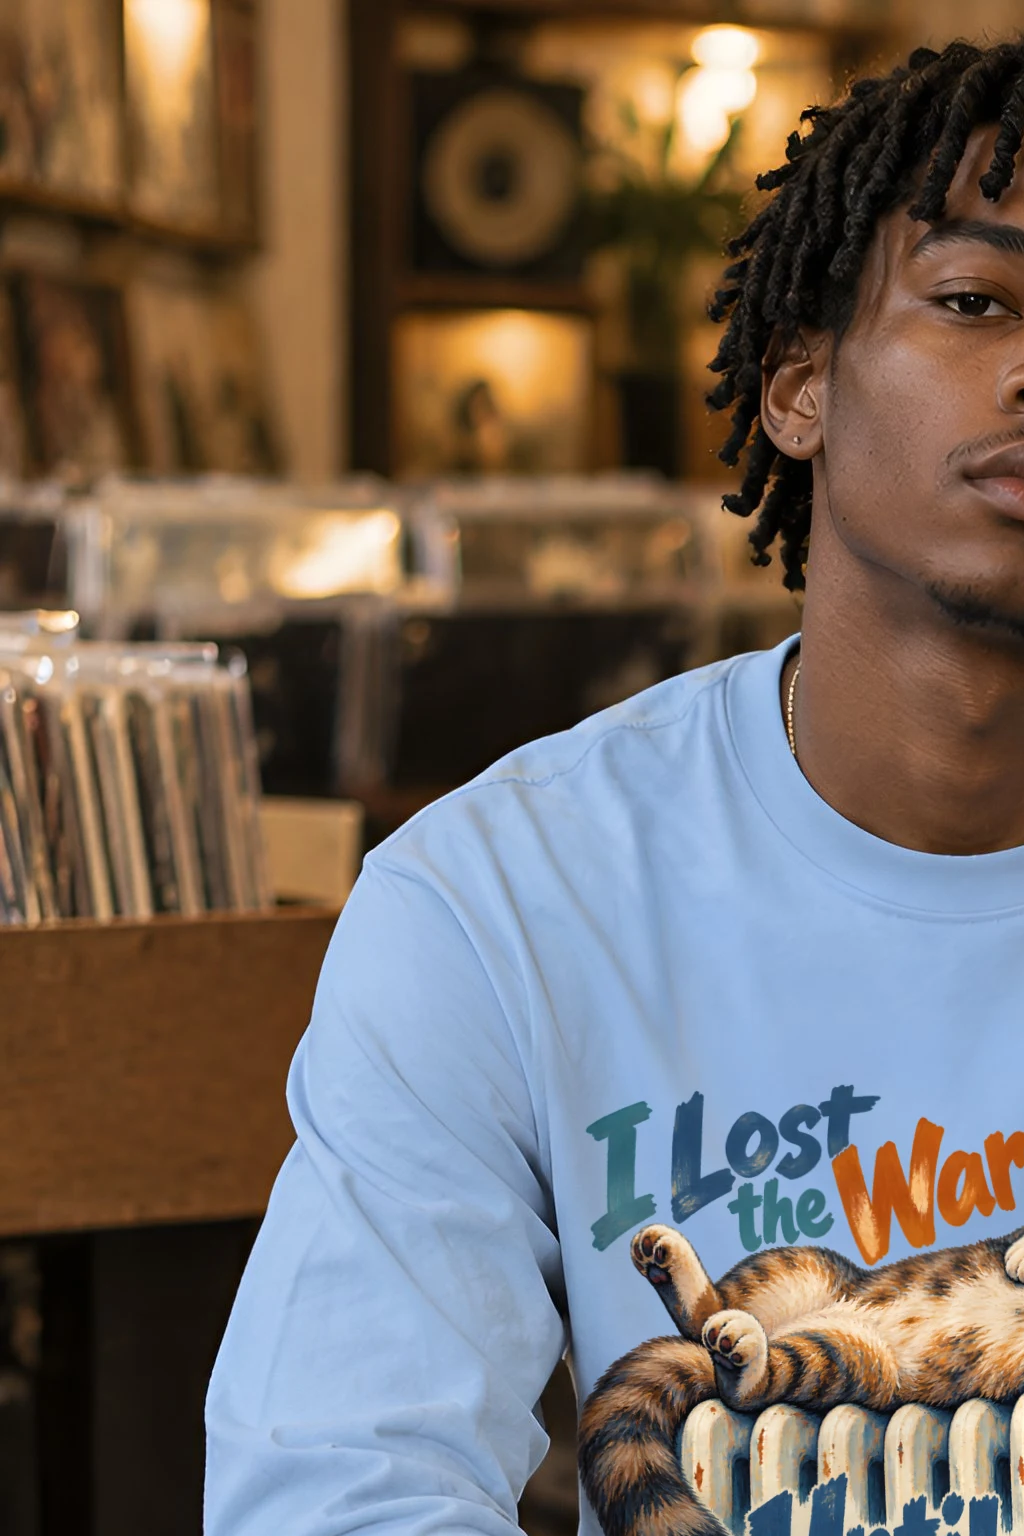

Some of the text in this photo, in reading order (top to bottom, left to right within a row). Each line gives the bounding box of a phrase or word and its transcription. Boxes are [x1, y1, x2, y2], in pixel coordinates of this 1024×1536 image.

[586, 1101, 657, 1252] I
[671, 1084, 881, 1224] Lost
[727, 1177, 834, 1252] the
